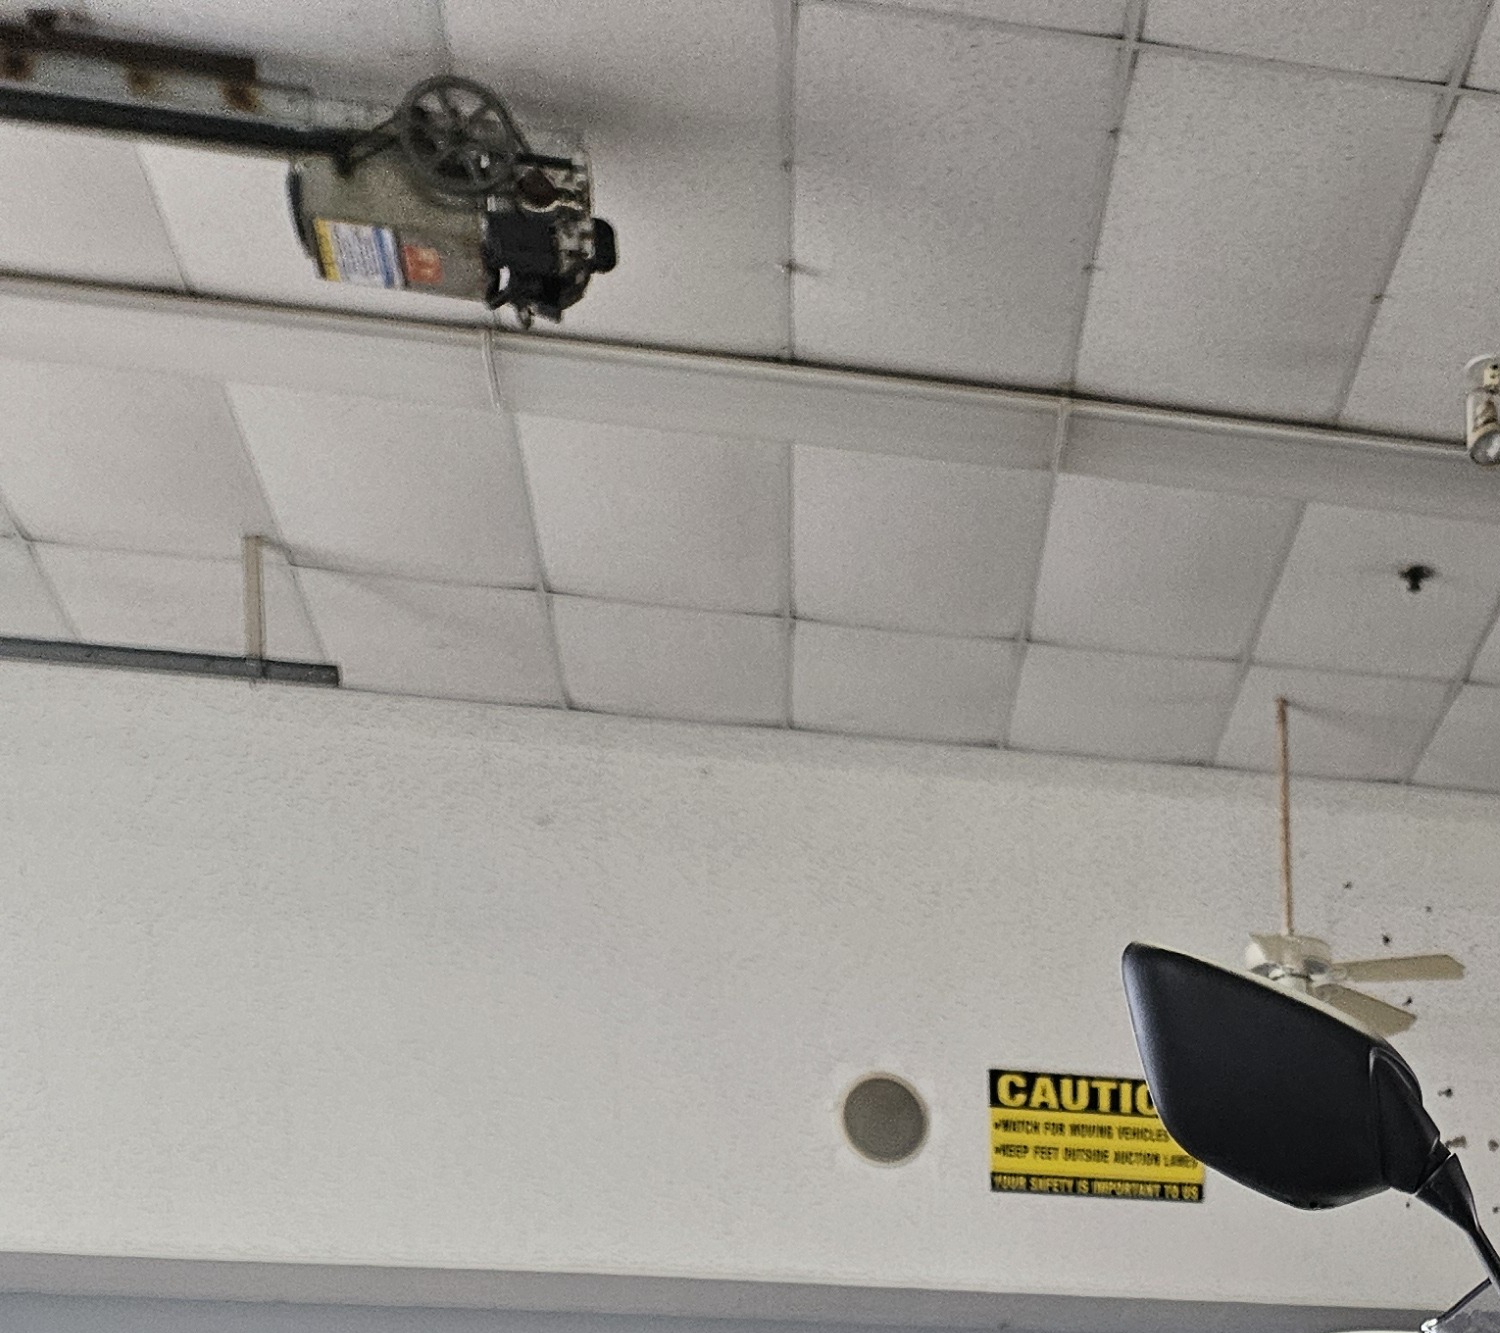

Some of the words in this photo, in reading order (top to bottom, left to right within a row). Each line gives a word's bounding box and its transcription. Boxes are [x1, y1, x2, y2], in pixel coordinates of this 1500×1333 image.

[997, 1074, 1158, 1117] CAUTIO
[1044, 1121, 1065, 1136] FOR
[1070, 1123, 1113, 1140] MOVING
[1117, 1125, 1170, 1143] VEHICLES
[1001, 1144, 1028, 1160] KEEP
[1033, 1146, 1059, 1161] FEET
[1064, 1147, 1109, 1164] OUTSIDE
[1114, 1150, 1160, 1167] AUCTION
[994, 1174, 1027, 1190] YOUR
[1029, 1176, 1073, 1193] SAFETY
[1077, 1178, 1089, 1194] IS
[1093, 1180, 1161, 1198] IMPORTANT
[1164, 1184, 1179, 1199] TO
[1181, 1185, 1199, 1200] US
